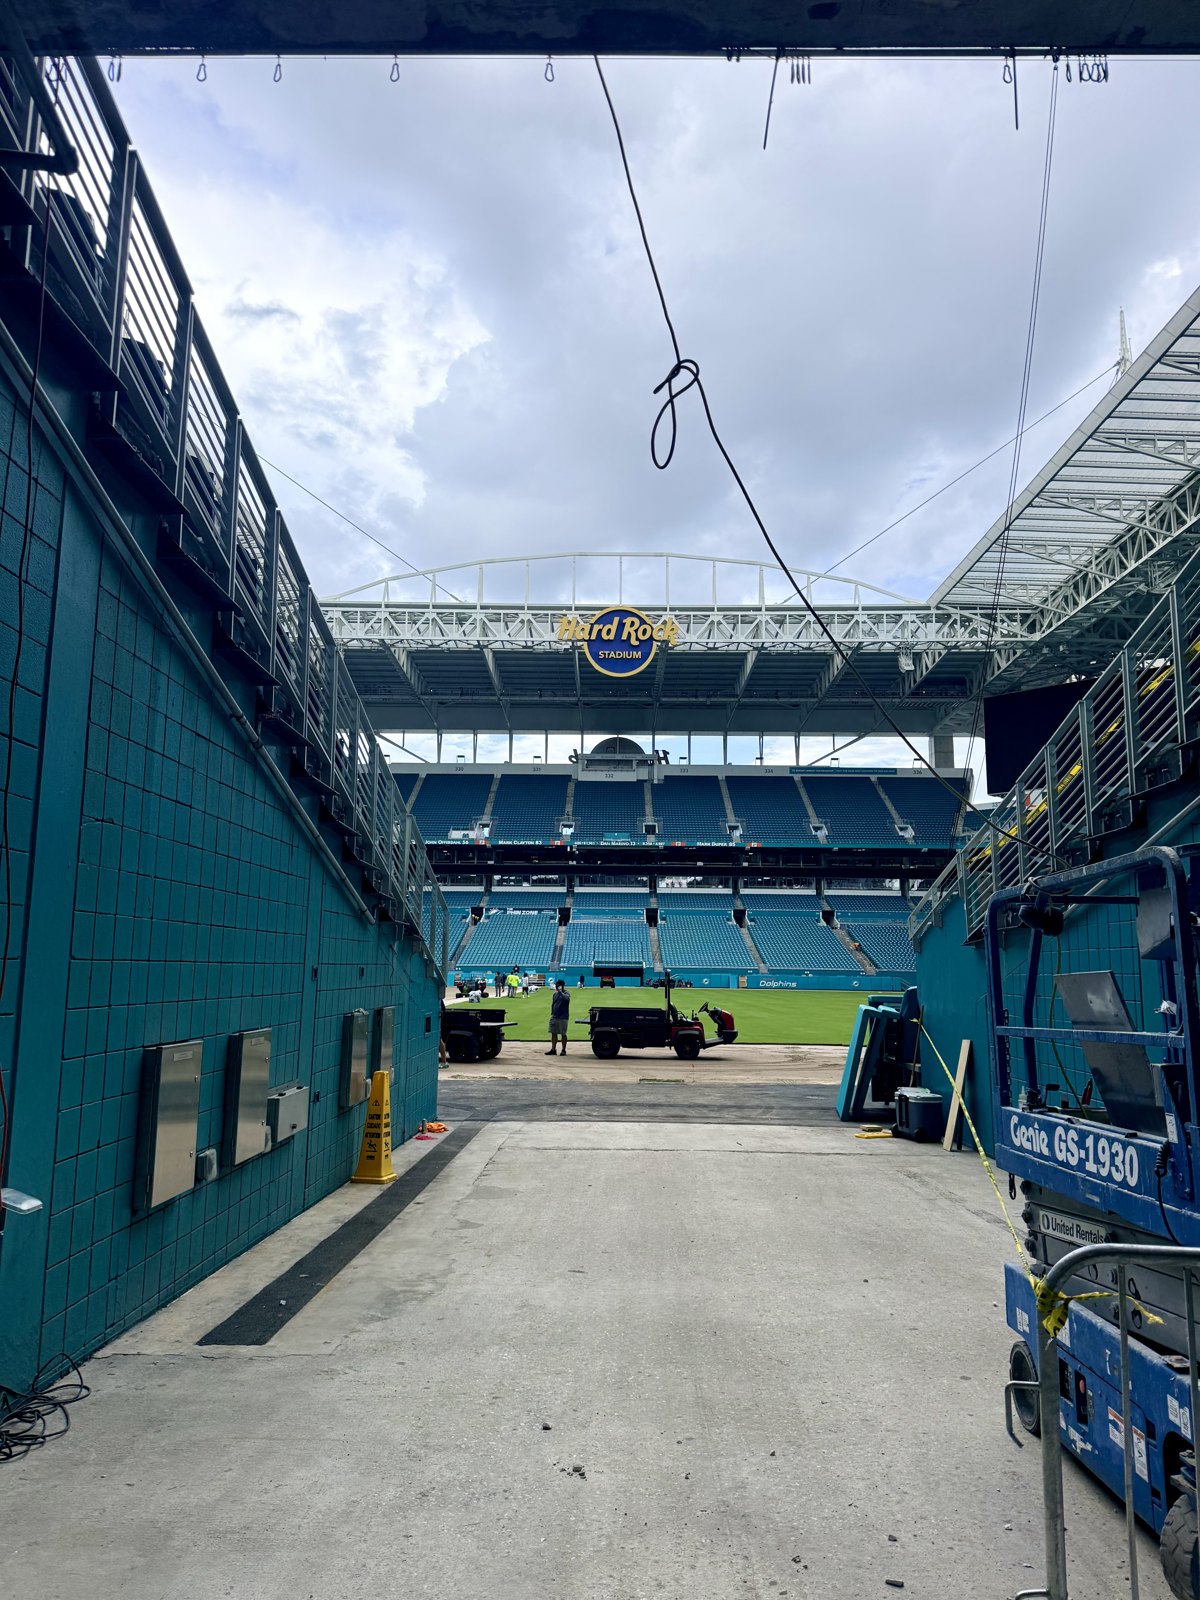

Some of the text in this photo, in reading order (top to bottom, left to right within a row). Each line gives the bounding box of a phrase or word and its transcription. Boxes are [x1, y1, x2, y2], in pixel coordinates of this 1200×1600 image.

[557, 615, 680, 646] Hard Rock
[598, 650, 642, 659] STADIUM
[759, 979, 797, 988] Dolphins
[1010, 1115, 1050, 1156] Genie
[1053, 1125, 1139, 1187] GS-1930
[1051, 1217, 1105, 1244] United Rentals
